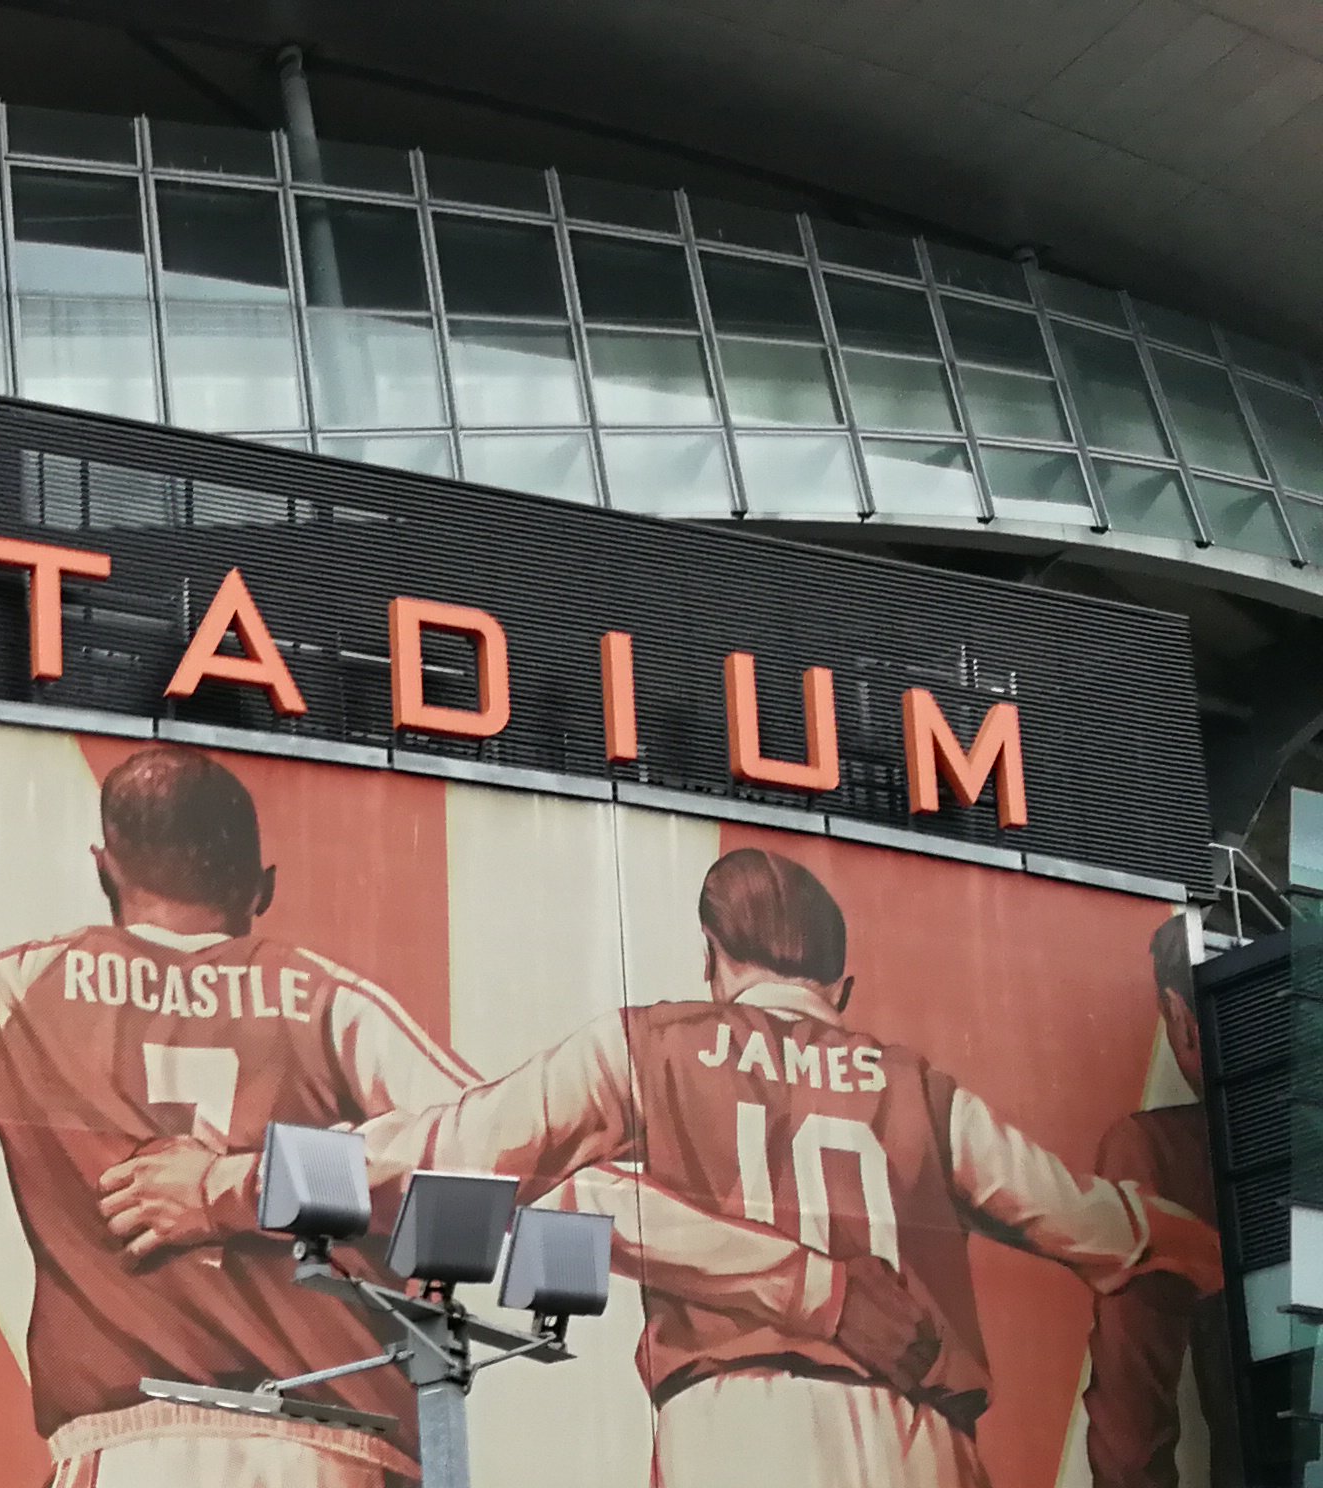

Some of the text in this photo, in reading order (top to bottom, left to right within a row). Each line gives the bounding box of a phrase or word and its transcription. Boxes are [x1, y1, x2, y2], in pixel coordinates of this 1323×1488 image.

[64, 948, 311, 1023] ROCASTLE
[697, 1023, 887, 1094] JAMES
[735, 1100, 901, 1273] 10
